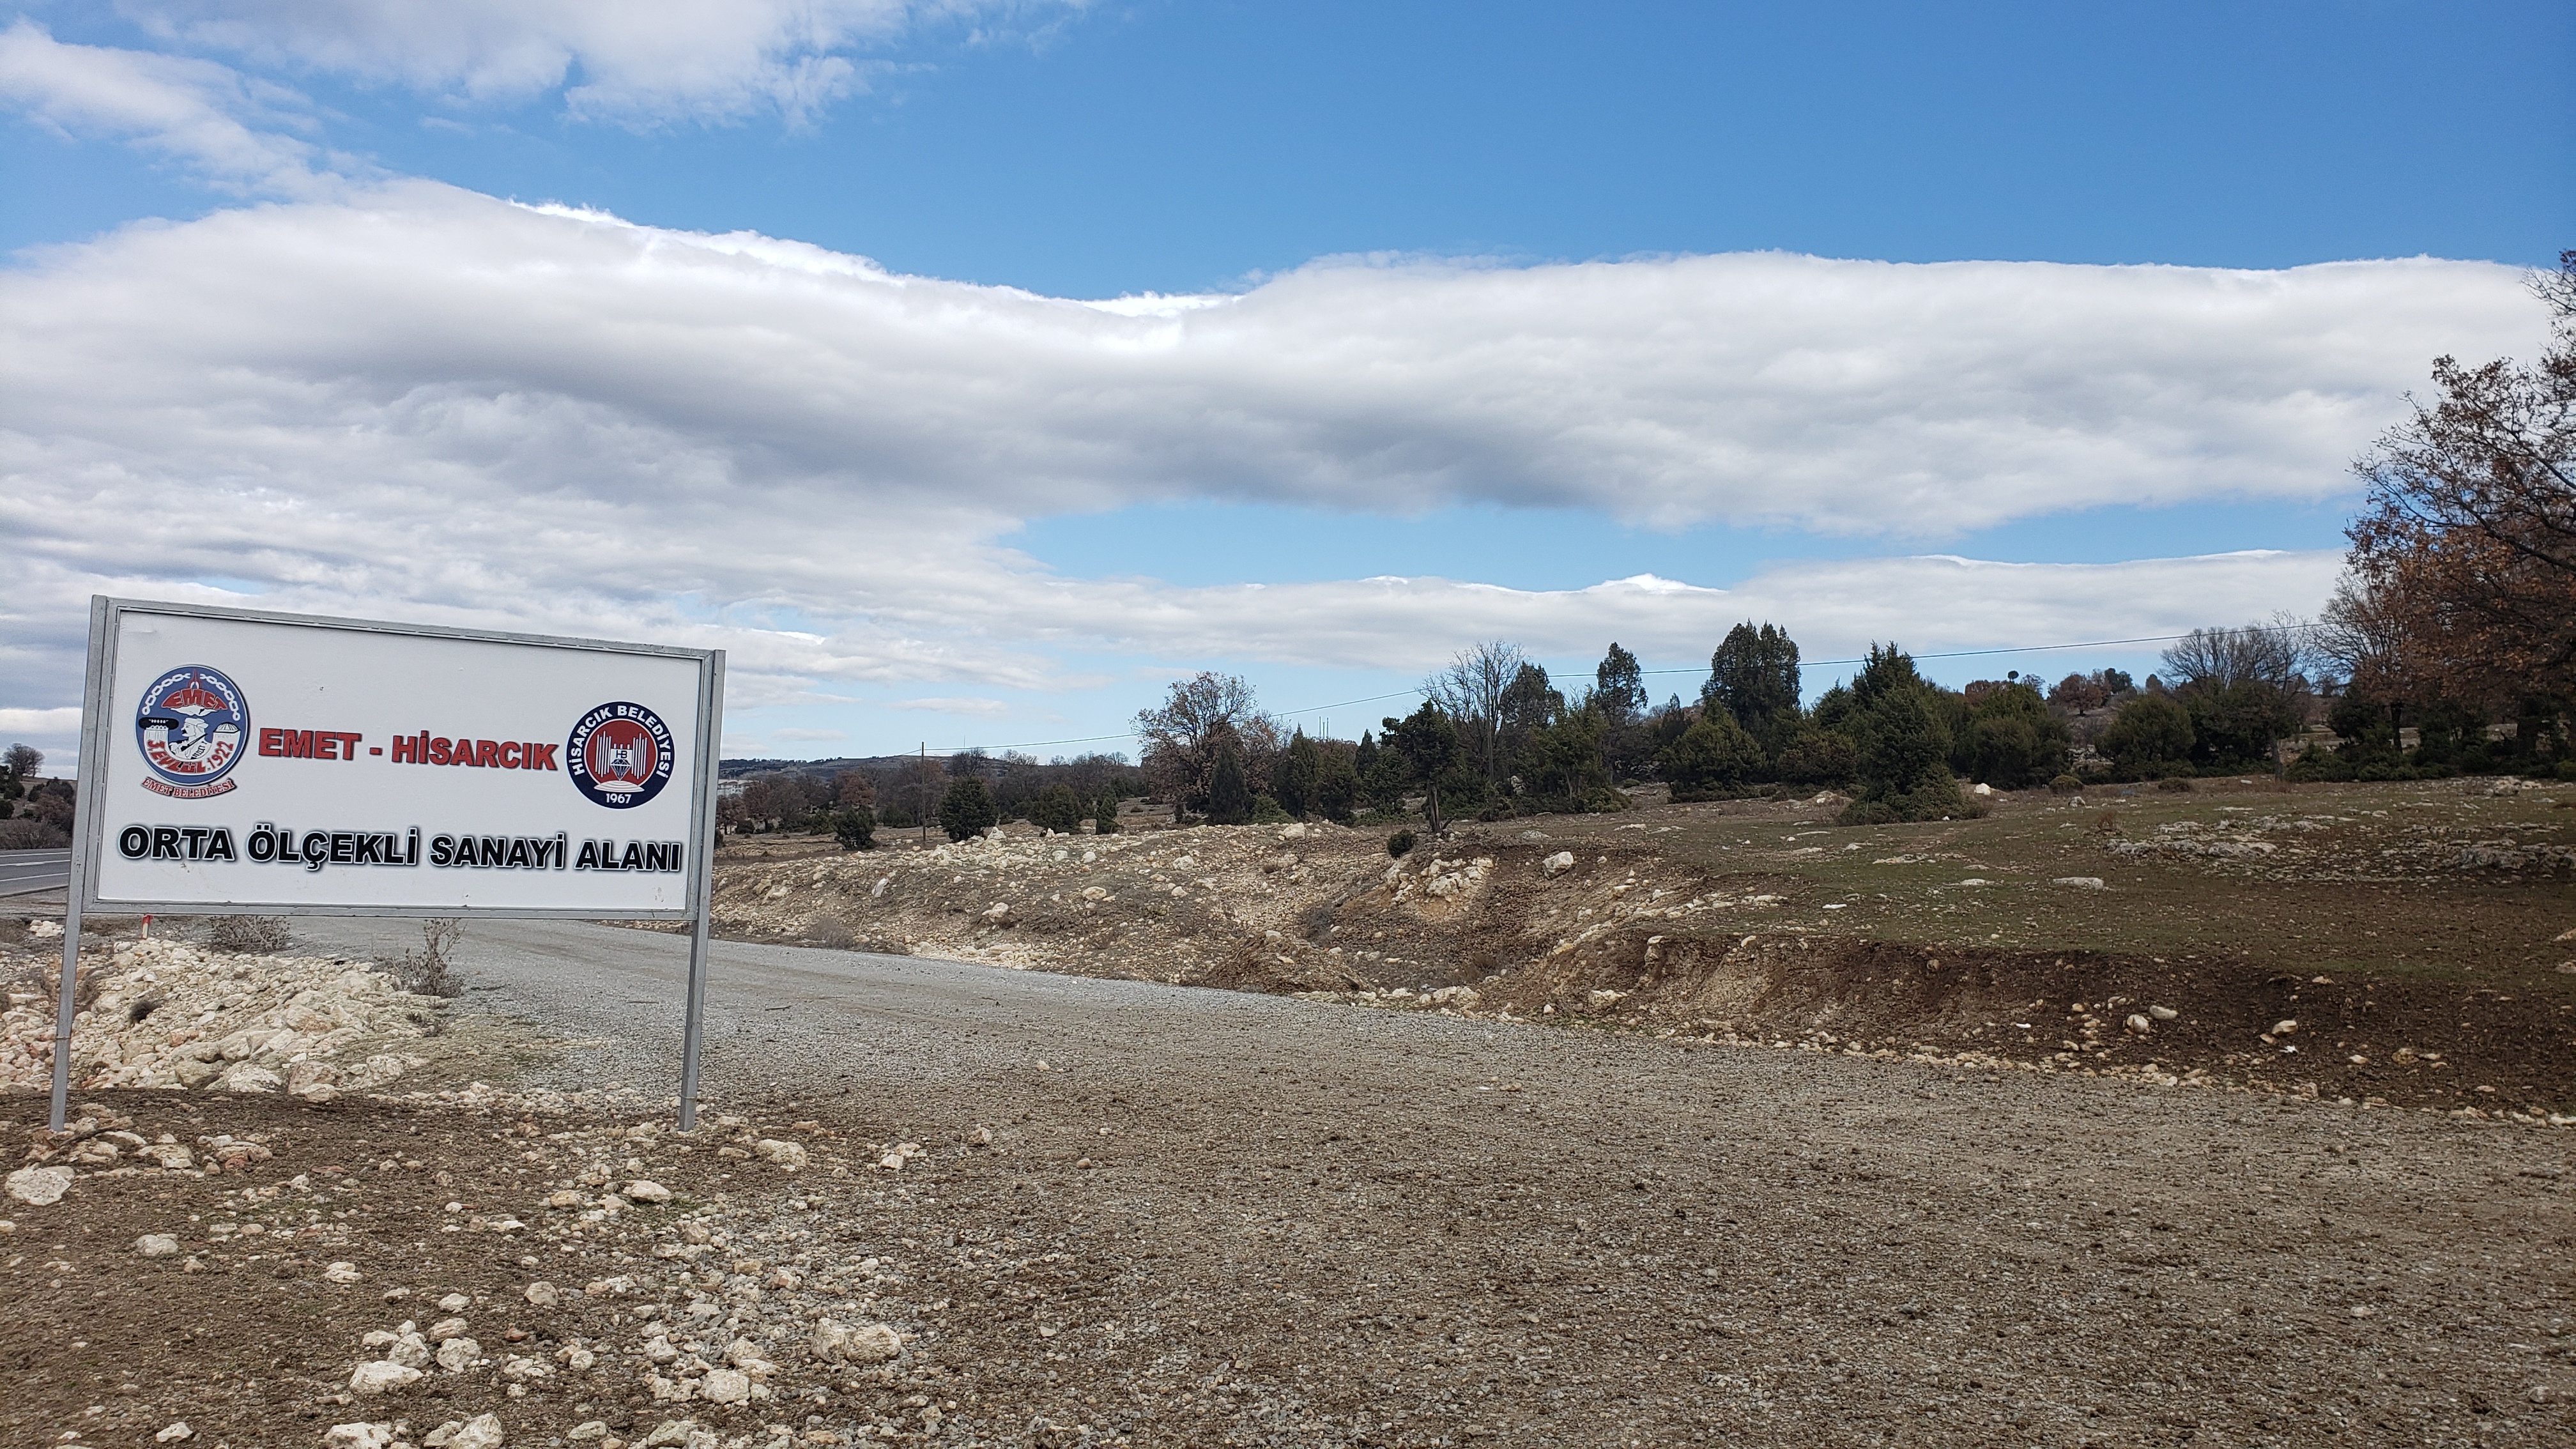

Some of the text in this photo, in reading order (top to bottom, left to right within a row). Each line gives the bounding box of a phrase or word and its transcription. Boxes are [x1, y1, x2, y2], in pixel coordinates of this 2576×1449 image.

[161, 689, 227, 710] EMET
[258, 728, 559, 771] EMET - HİSARCIK
[142, 778, 172, 795] EMET
[606, 793, 631, 804] 1967
[118, 824, 680, 872] ORTA ÖLÇEKLİ SANAYİ ALANI
